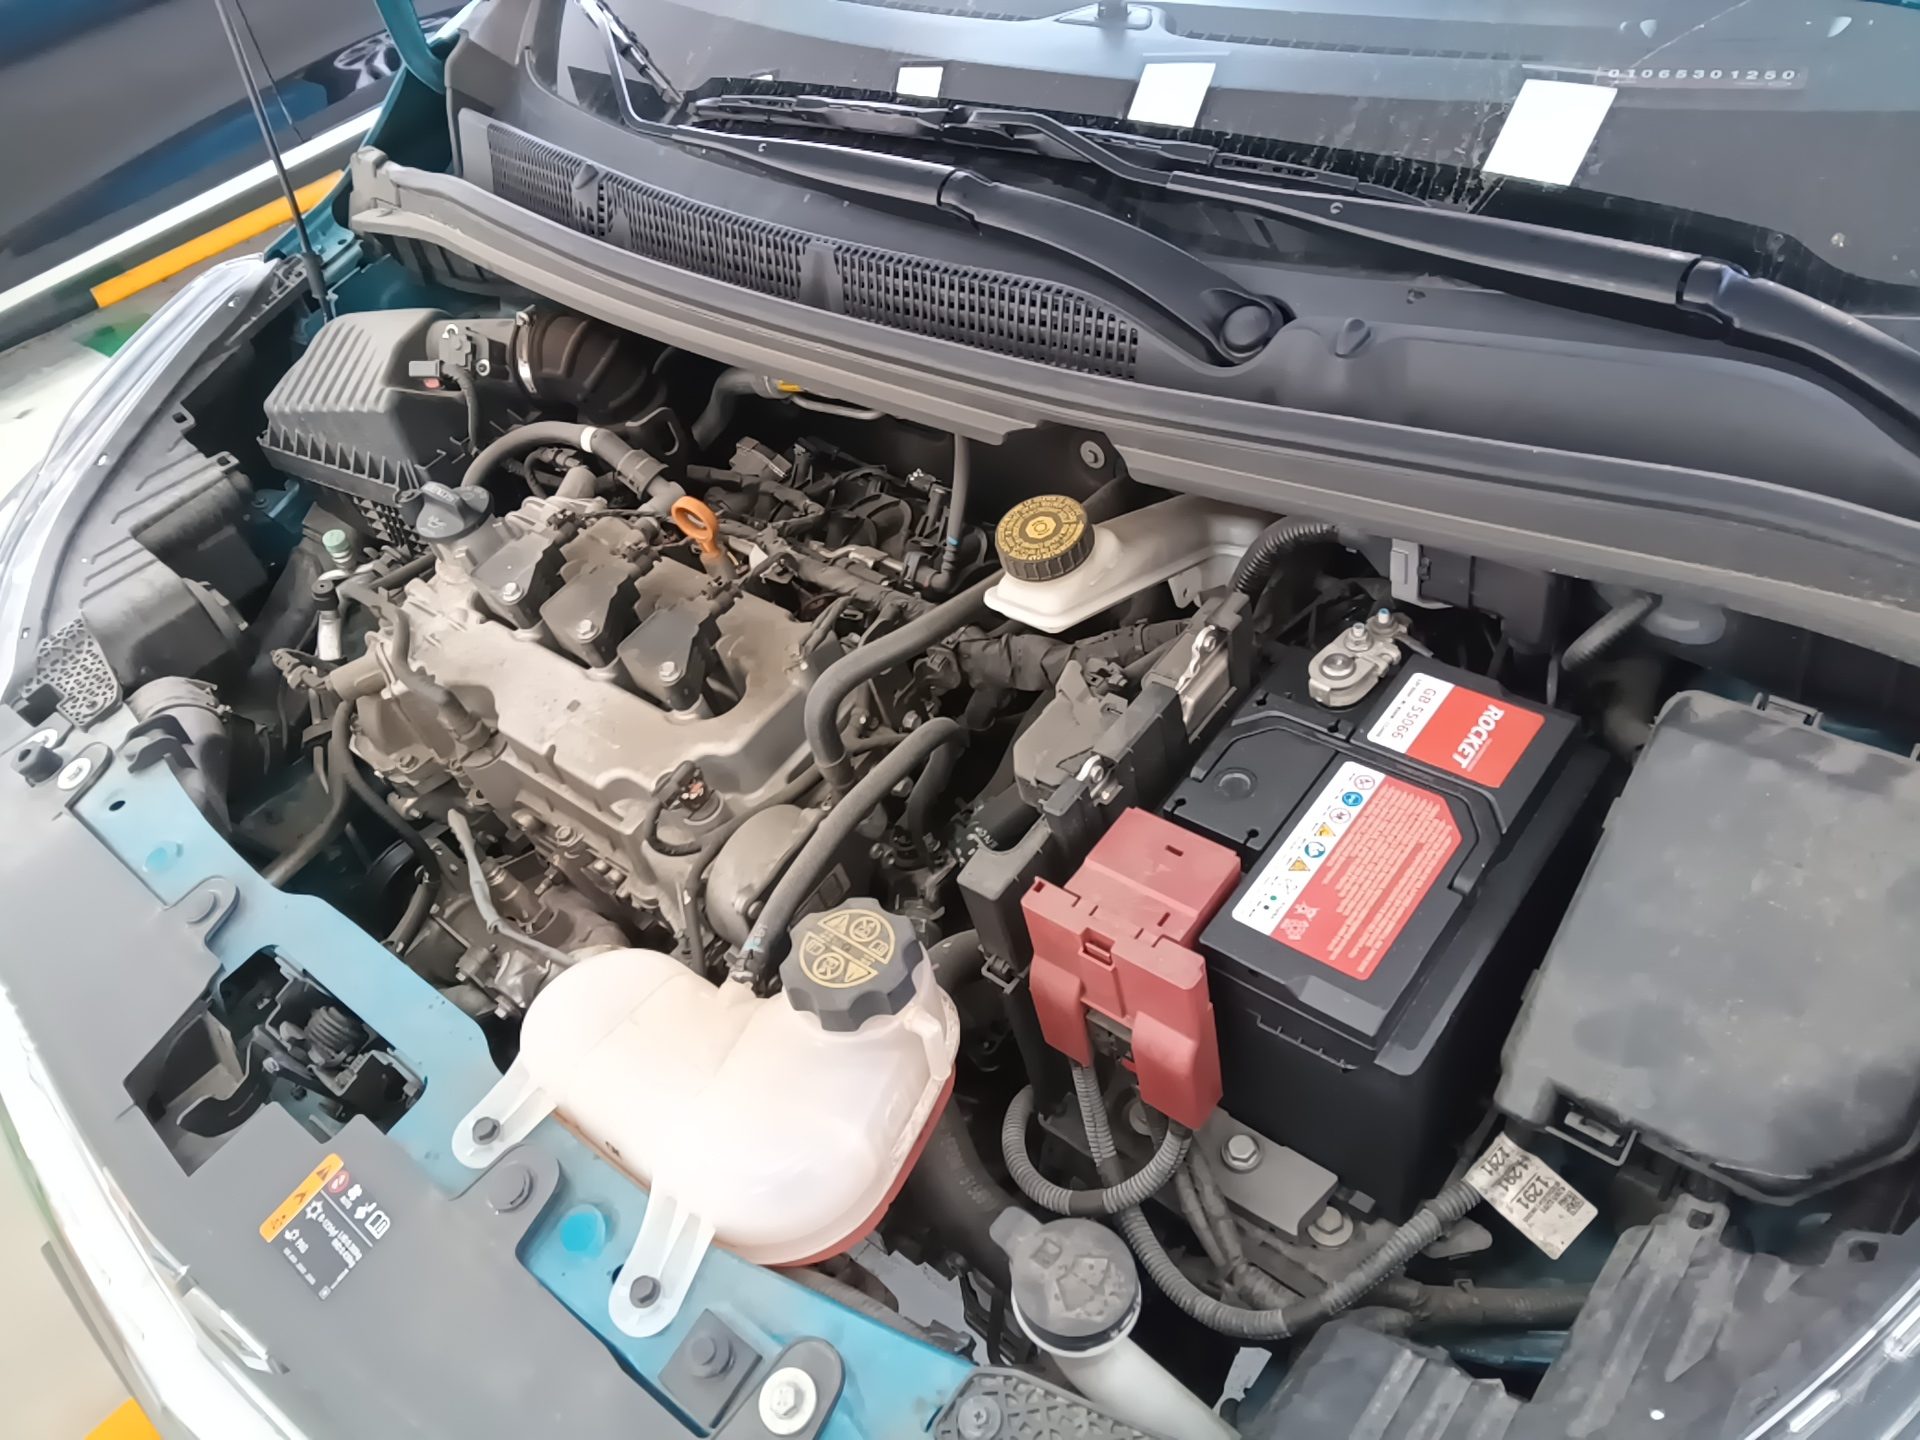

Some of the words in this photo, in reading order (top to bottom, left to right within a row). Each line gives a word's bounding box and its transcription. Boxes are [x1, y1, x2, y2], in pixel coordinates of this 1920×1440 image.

[1419, 688, 1437, 704] GB
[1452, 703, 1505, 769] ROCKET
[1479, 1146, 1510, 1177] 1291
[1516, 1175, 1549, 1210] 1291
